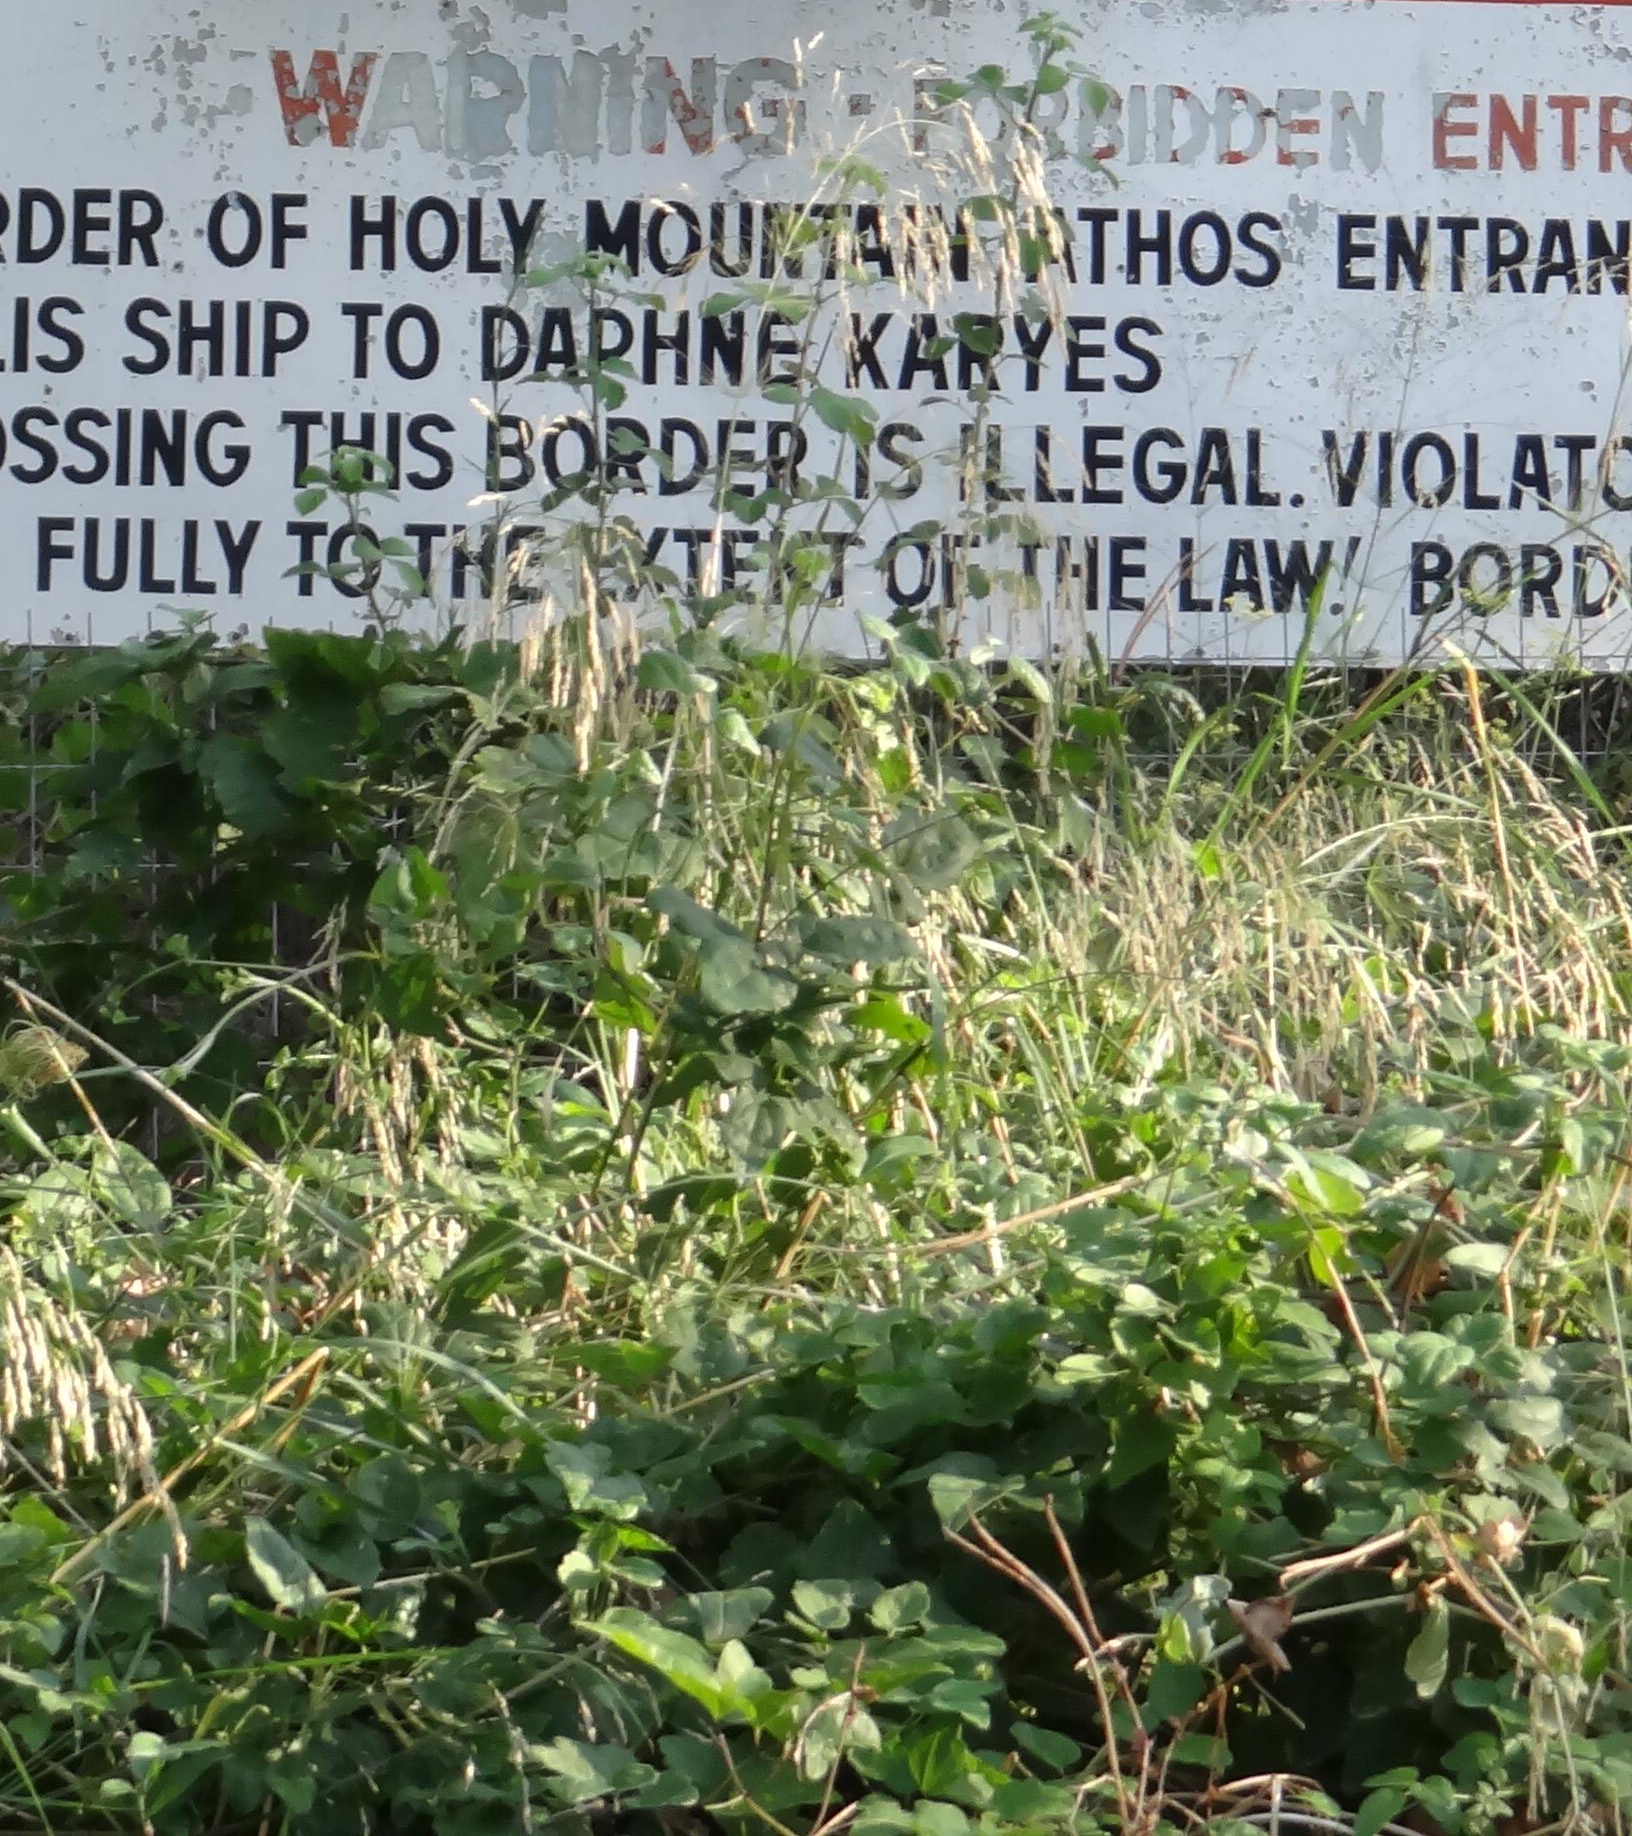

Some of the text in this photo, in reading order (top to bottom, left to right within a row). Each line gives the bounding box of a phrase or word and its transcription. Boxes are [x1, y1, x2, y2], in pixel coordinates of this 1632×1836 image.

[269, 50, 805, 161] WARNING
[206, 190, 308, 270] OF
[349, 194, 546, 275] HOLY
[122, 297, 309, 378] SHIP
[342, 302, 440, 380] TO
[480, 305, 800, 387] DAPHNE
[846, 311, 1163, 394] KARYES
[281, 410, 456, 491] THIS
[484, 413, 809, 500] BORDER
[854, 422, 925, 501] IS
[960, 422, 1305, 509] ILLEGAL.
[36, 515, 263, 595] FULLY
[286, 520, 382, 599] TO
